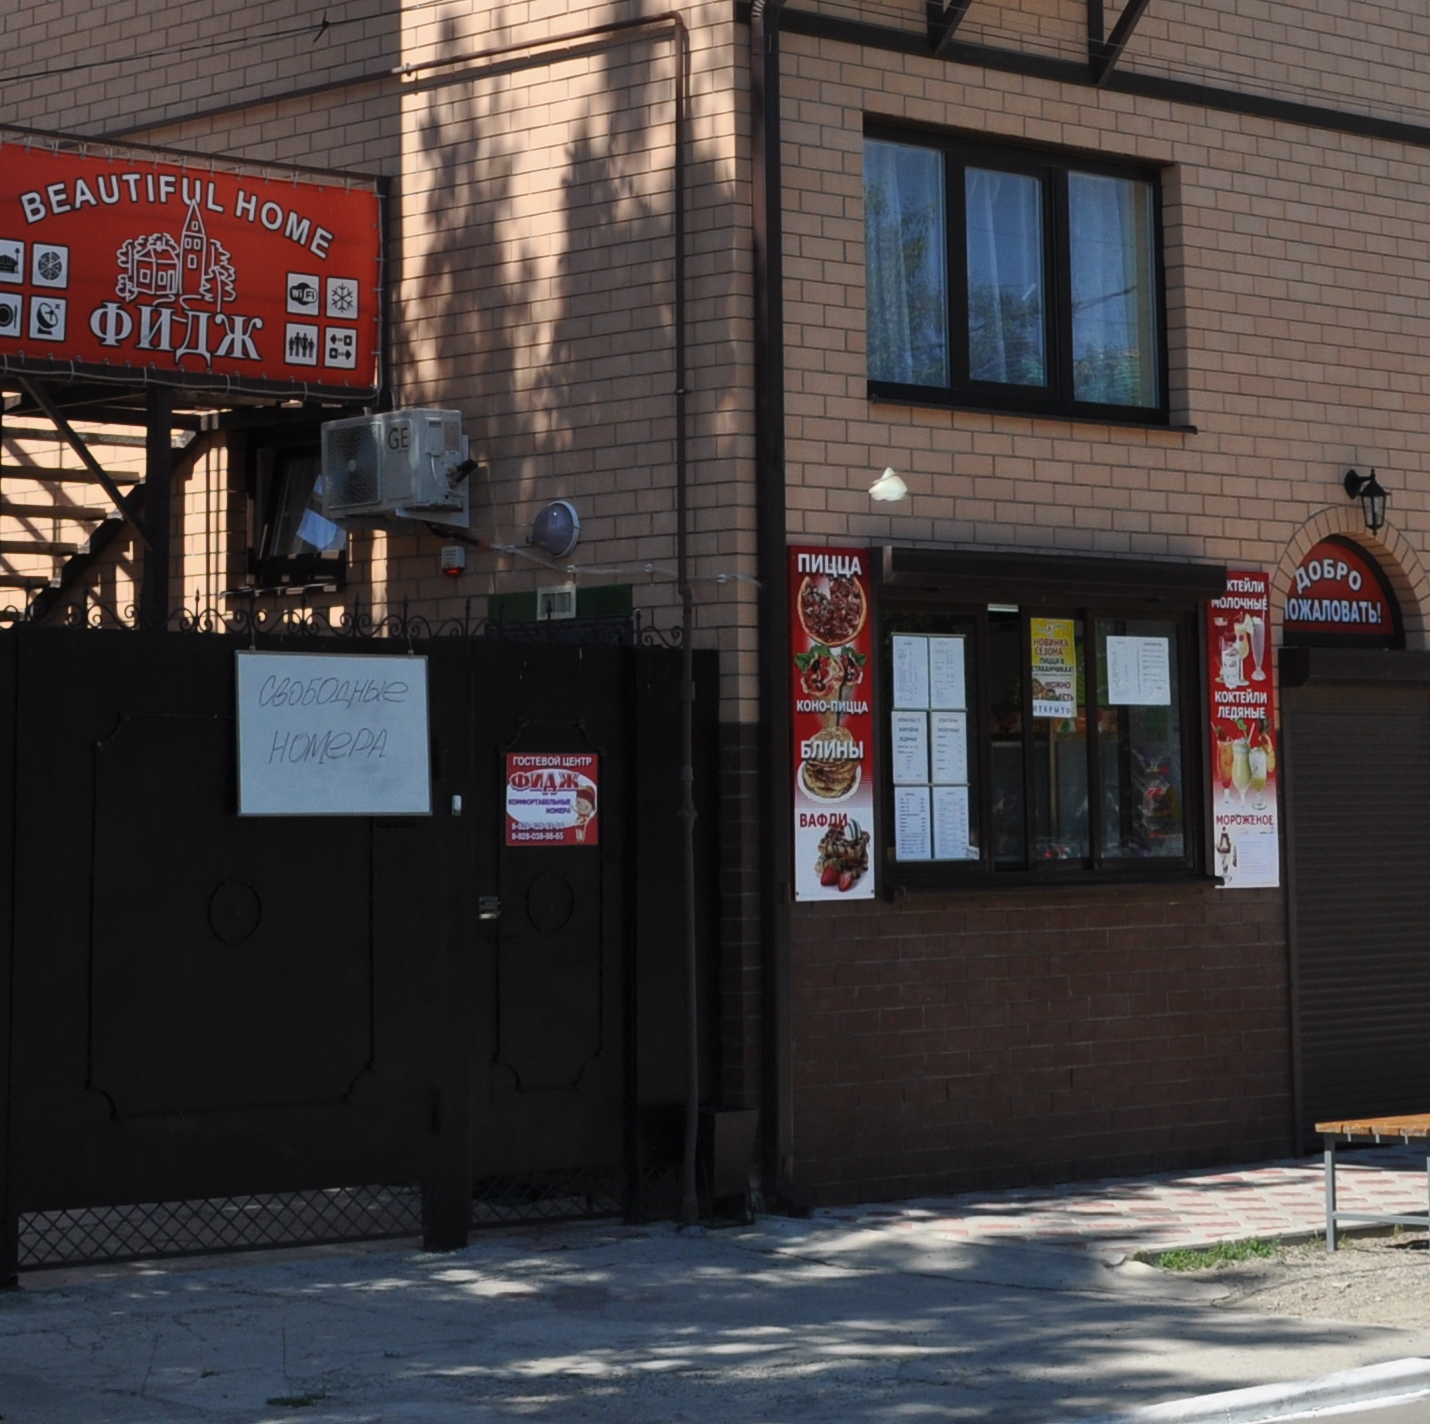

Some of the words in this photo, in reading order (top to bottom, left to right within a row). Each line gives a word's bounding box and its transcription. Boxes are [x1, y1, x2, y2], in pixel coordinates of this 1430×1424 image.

[20, 173, 225, 224] BEAUTIFUL
[234, 189, 335, 260] HOME
[89, 302, 264, 367] ФИДЖ
[797, 553, 863, 579] ПИЦЦА
[1226, 576, 1265, 593] КТЕЙЛИ
[1294, 558, 1362, 595] ДОБРО
[1211, 596, 1268, 611] МОЛОЧНЫЕ
[1214, 688, 1268, 705] КОКТЕЙЛИ
[796, 699, 869, 715] КОНО-ПИЦЦА
[1217, 705, 1266, 721] ЛЕДЯНЫЕ
[800, 740, 864, 759] БЛИНЫ
[512, 756, 561, 767] ГОСТЕВОЙ
[562, 757, 592, 768] ЦЕНТР
[509, 771, 580, 795] ФИДЖ
[1215, 813, 1274, 826] МОРОЖЕНОЕ
